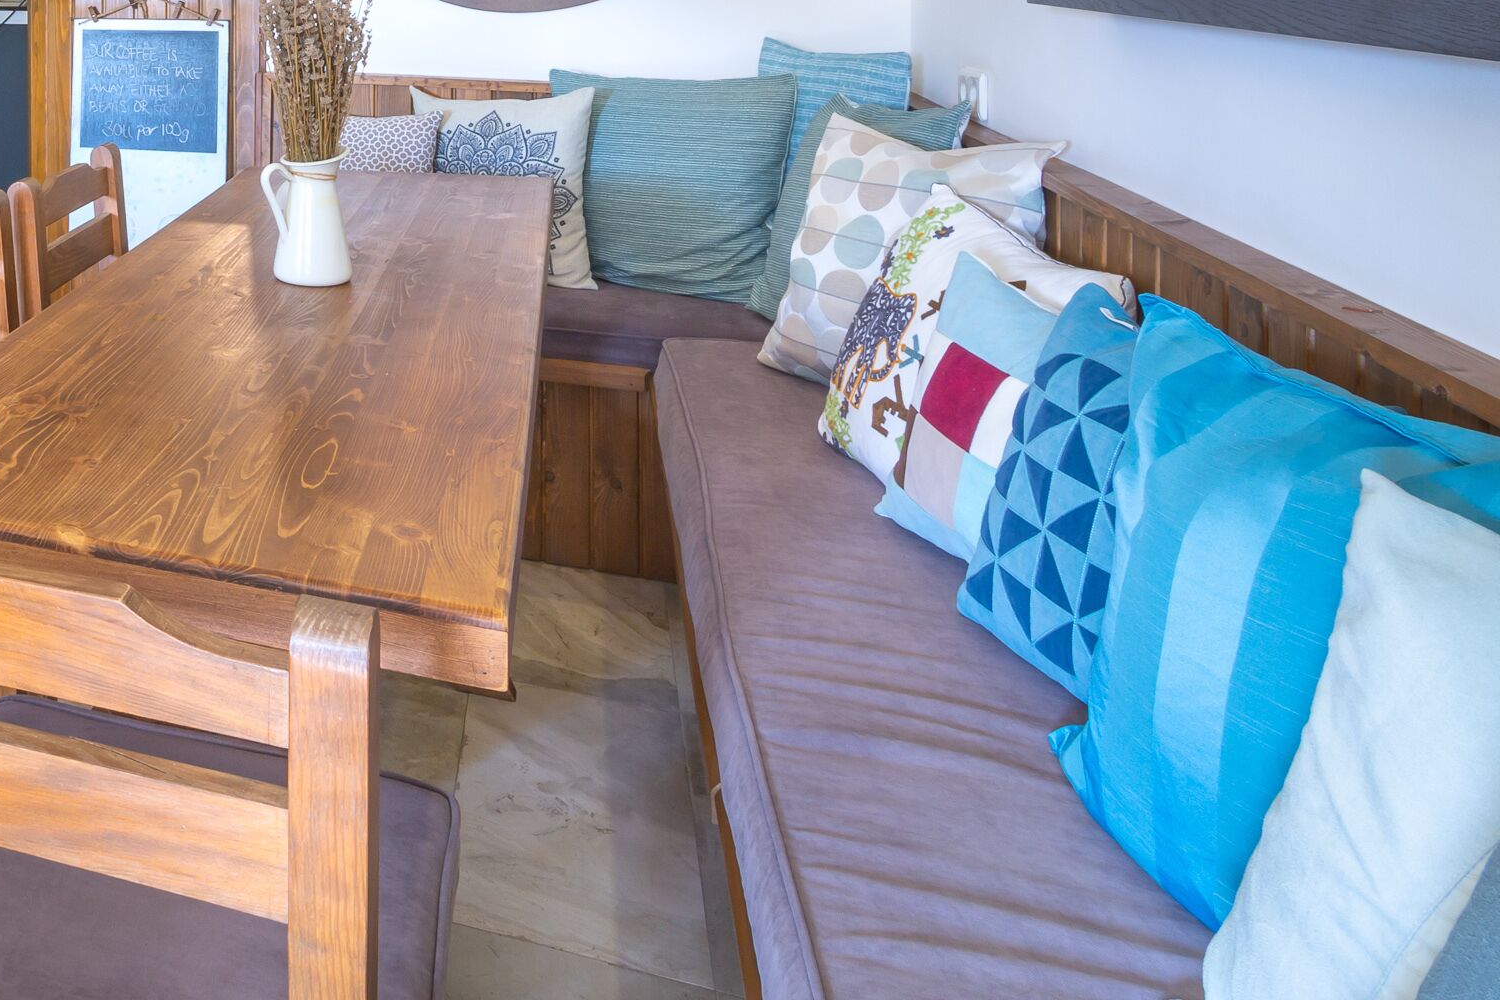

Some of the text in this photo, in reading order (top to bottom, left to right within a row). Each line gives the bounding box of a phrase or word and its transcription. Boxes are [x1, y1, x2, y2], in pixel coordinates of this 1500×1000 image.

[90, 41, 178, 61] OUR COFFEE IS
[153, 66, 170, 77] TO
[171, 66, 204, 80] TAKE
[89, 83, 124, 94] AWAY
[133, 99, 150, 114] OR
[136, 124, 159, 142] per
[161, 121, 190, 144] 100g
